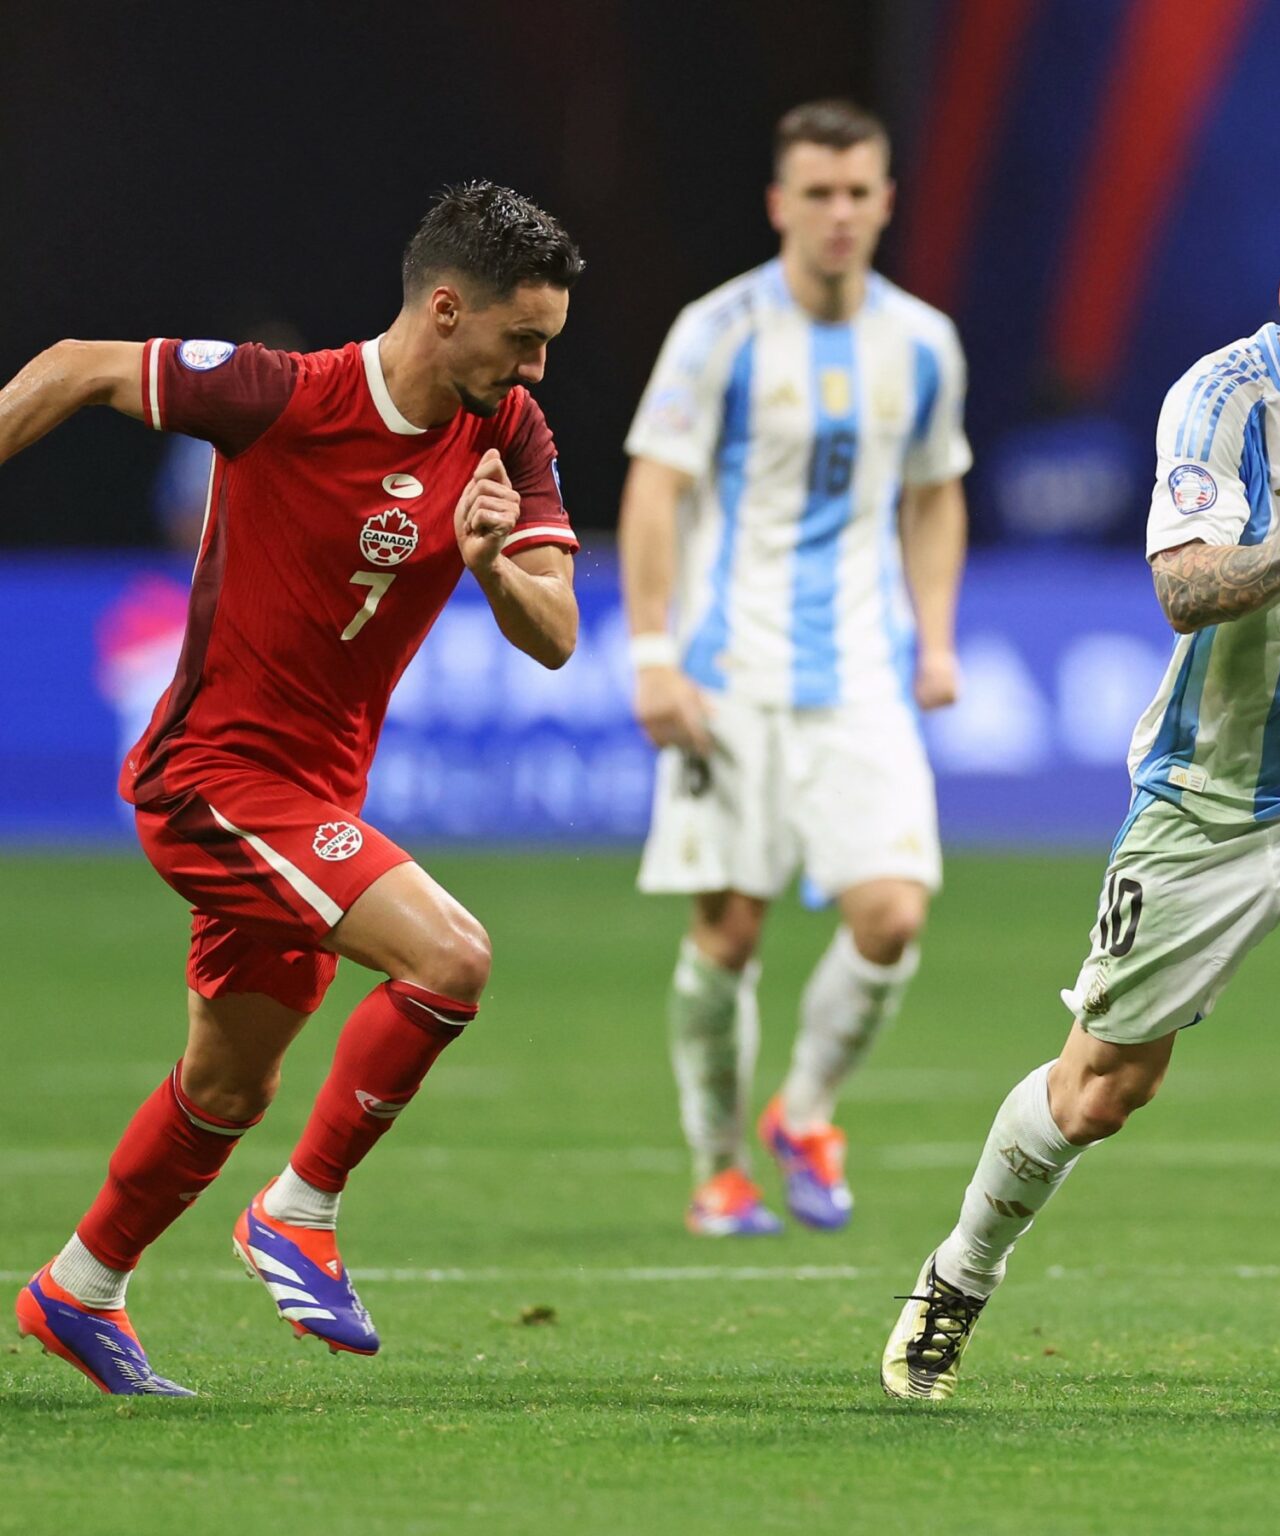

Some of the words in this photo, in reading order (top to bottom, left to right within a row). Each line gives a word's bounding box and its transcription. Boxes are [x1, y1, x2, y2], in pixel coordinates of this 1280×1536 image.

[806, 431, 857, 499] 16
[363, 531, 414, 548] CANADA
[340, 570, 397, 641] 7
[320, 828, 355, 856] CANADA
[1100, 873, 1143, 958] 10
